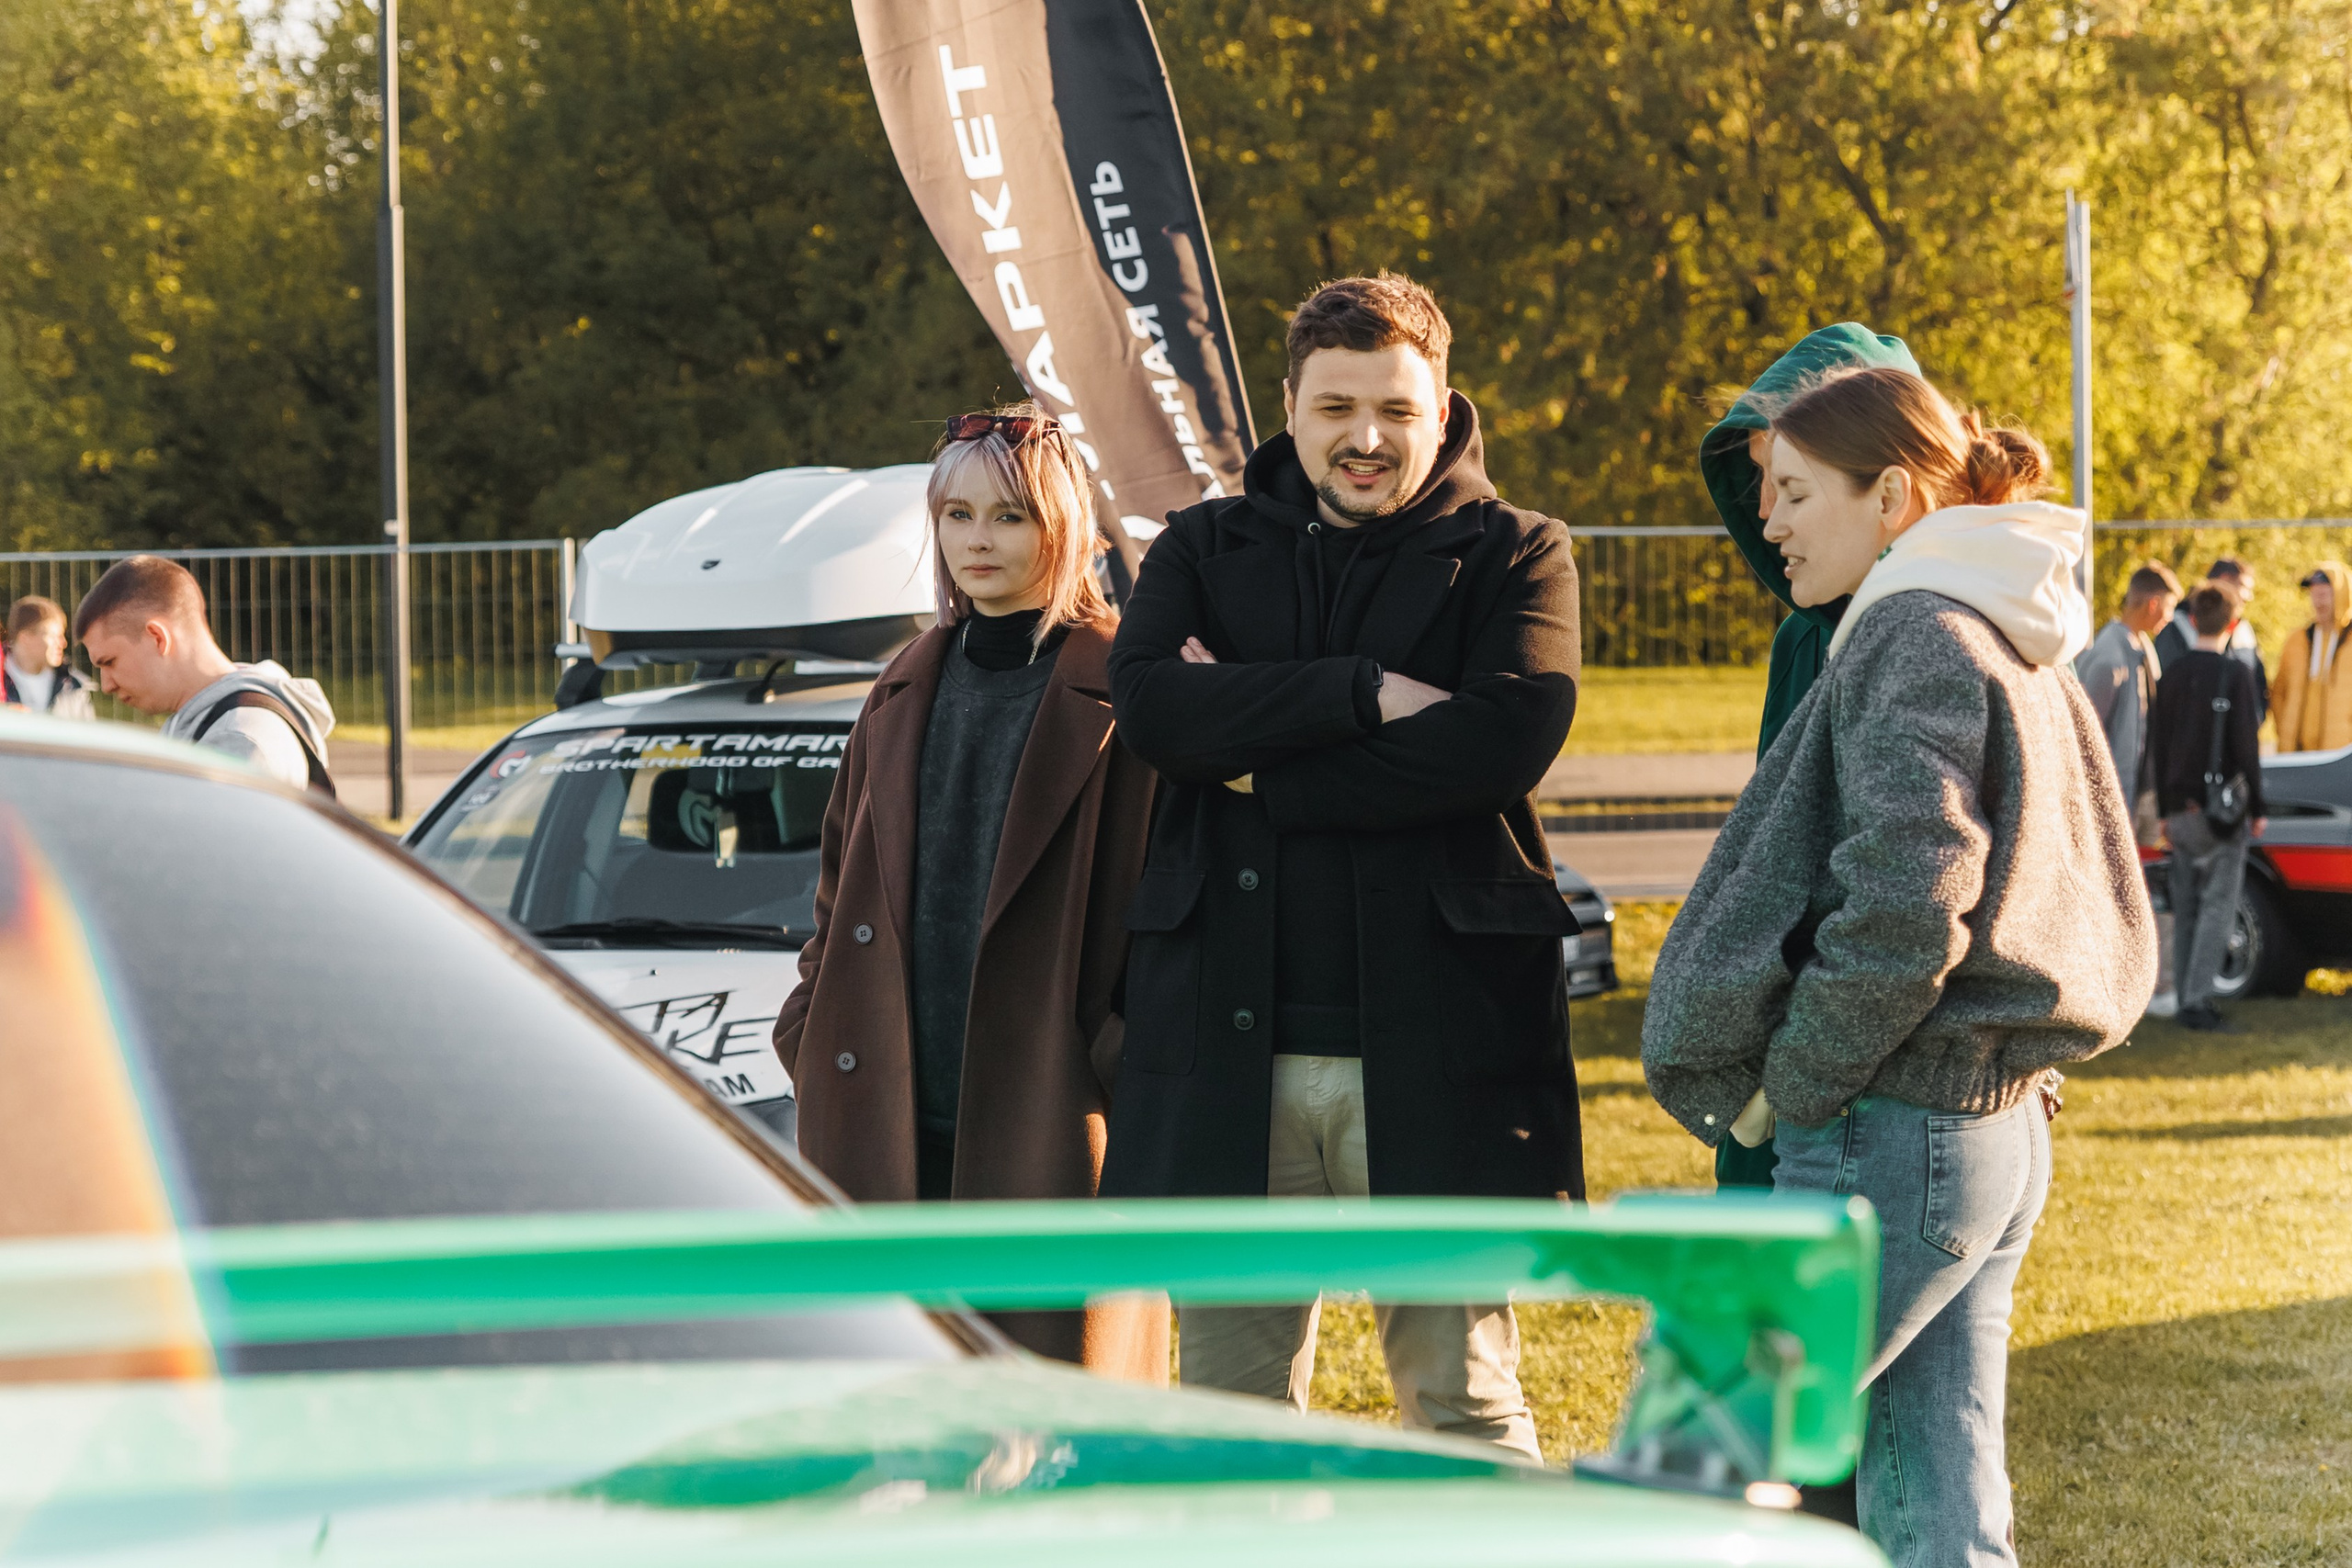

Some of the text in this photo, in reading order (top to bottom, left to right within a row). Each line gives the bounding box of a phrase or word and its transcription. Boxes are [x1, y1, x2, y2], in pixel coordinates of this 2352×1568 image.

[1090, 161, 1149, 293] СЕТЬ
[538, 756, 749, 775] BROTHERHOOD
[751, 756, 793, 768] OF
